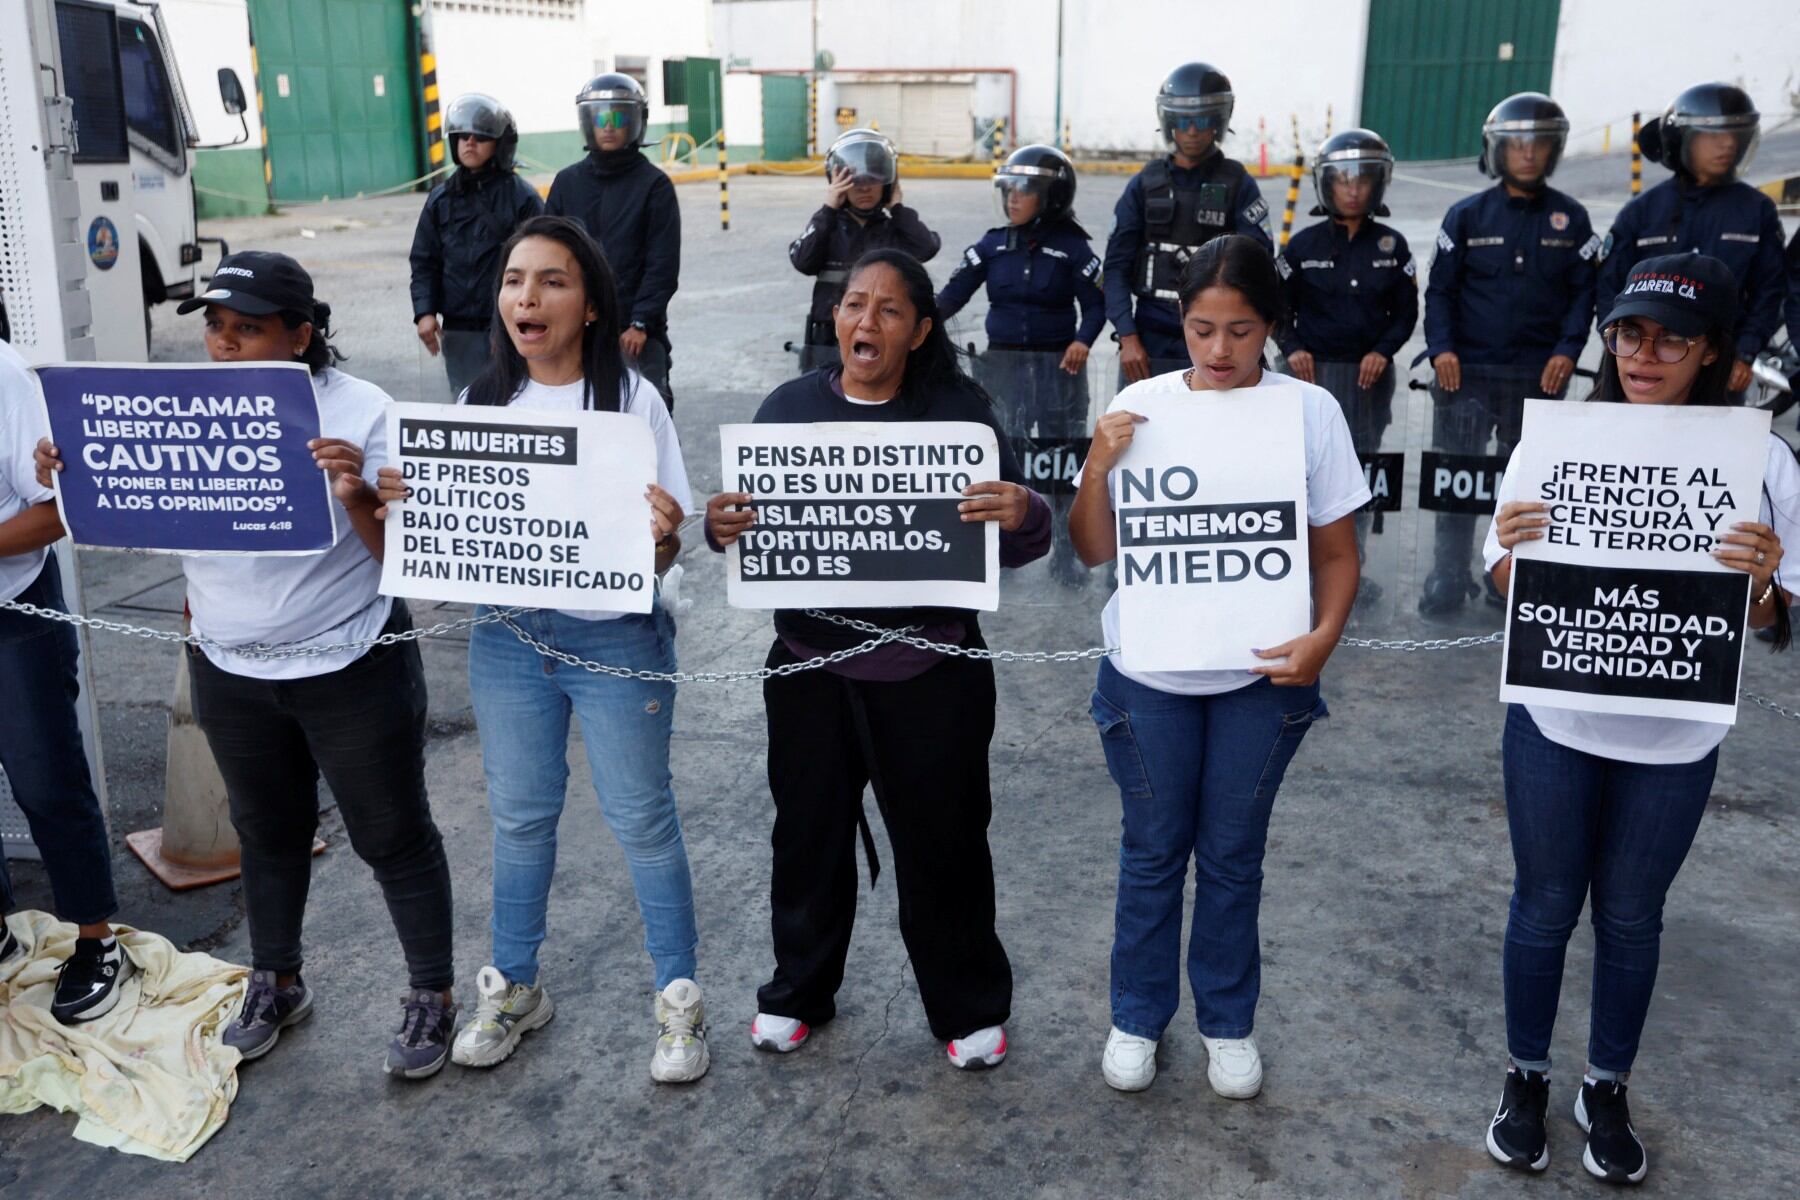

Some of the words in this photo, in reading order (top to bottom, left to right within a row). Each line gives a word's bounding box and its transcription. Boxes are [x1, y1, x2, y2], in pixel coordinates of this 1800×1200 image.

[83, 419, 201, 439] LIBERTAD
[208, 422, 227, 439] A
[232, 421, 281, 439] LOS
[403, 428, 445, 449] LAS
[452, 431, 565, 456] MUERTES
[83, 443, 281, 472] CAUTIVOS
[738, 446, 844, 466] PENSAR
[854, 445, 984, 466] DISTINTO
[1024, 448, 1079, 480] ICÍA
[92, 476, 103, 488] Y
[108, 477, 166, 490] PONER
[171, 478, 194, 490] EN
[198, 478, 284, 490] LIBERTAD
[402, 463, 430, 480] DE
[438, 464, 529, 487] PRESOS
[738, 474, 775, 494] NO
[784, 474, 817, 493] ES
[825, 474, 863, 493] UN
[872, 473, 971, 493] DELITO
[1122, 466, 1198, 503] NO
[1434, 468, 1504, 500] POLI
[1554, 462, 1678, 485] ¡FRENTE
[1687, 468, 1727, 486] AL
[97, 494, 111, 508] A
[115, 495, 154, 510] LOS
[403, 485, 525, 511] POLÍTICOS
[1541, 484, 1687, 511] SILENCIO,
[1698, 491, 1736, 509] LA
[233, 522, 266, 530] Lucas
[269, 521, 292, 530] 4:18
[403, 510, 458, 531] BAJO
[466, 515, 589, 539] CUSTODIA
[743, 505, 892, 525] ISLARLOS
[898, 506, 916, 524] Y
[1126, 510, 1282, 538] TENEMOS
[1550, 503, 1693, 530] CENSURA
[1705, 513, 1723, 531] Y
[404, 535, 445, 554] DEL
[452, 538, 542, 561] ESTADO
[550, 545, 579, 563] SE
[741, 530, 950, 555] TORTURARLOS,
[1548, 528, 1580, 546] EL
[403, 559, 450, 579] HAN
[458, 563, 643, 591] INTENSIFICADO
[744, 551, 770, 575] SÍ
[776, 556, 810, 575] LO
[817, 556, 851, 575] ES
[1125, 547, 1291, 585] MIEDO
[1594, 585, 1659, 609] MÁS
[1518, 603, 1734, 640] SOLIDARIDAD,
[1546, 628, 1672, 655] VERDAD
[1682, 638, 1702, 657] Y
[1542, 650, 1701, 680] DIGNIDAD!
